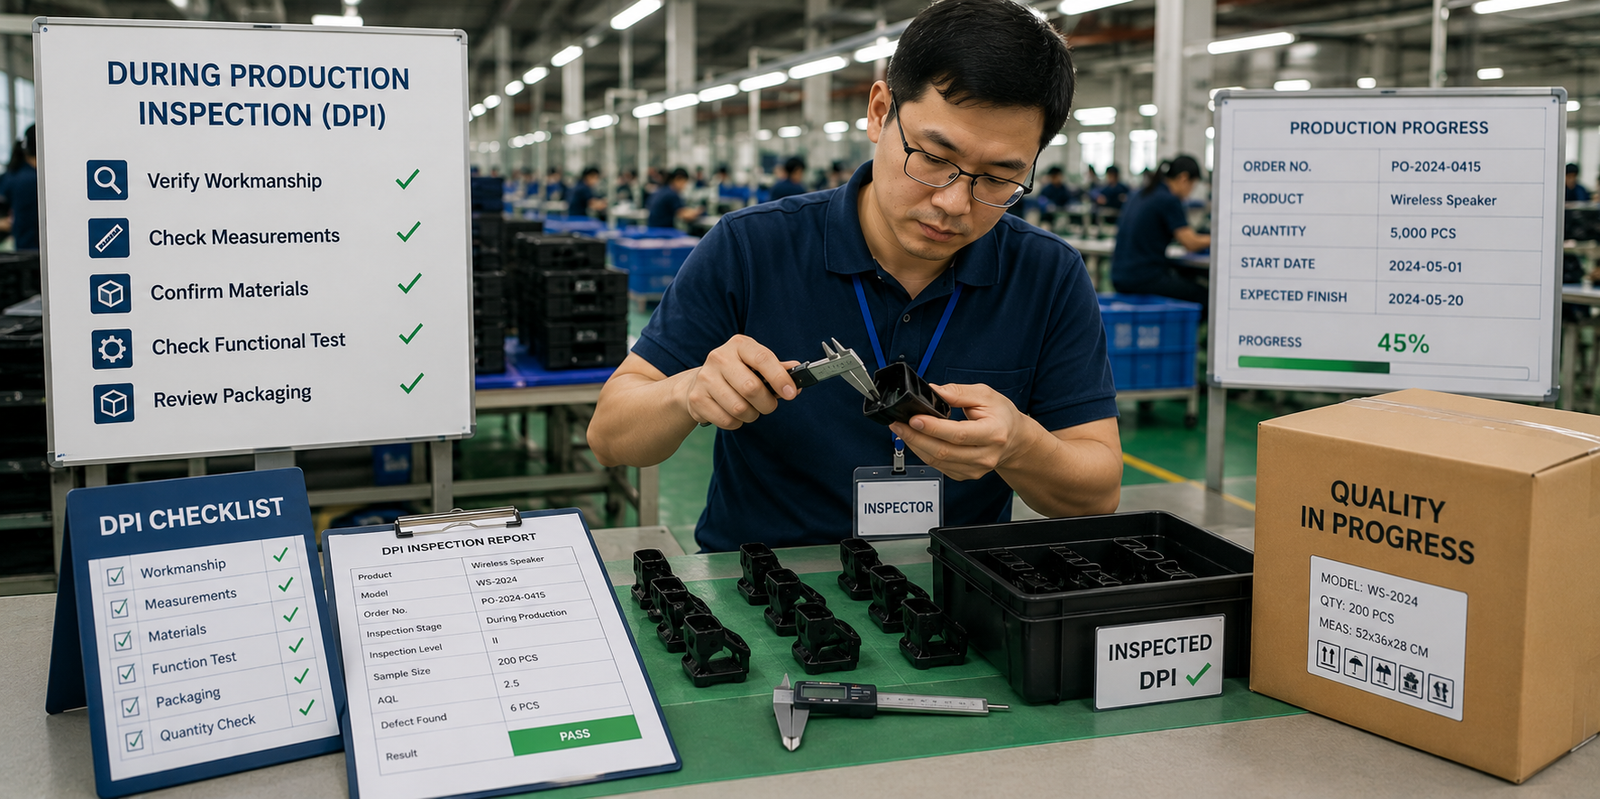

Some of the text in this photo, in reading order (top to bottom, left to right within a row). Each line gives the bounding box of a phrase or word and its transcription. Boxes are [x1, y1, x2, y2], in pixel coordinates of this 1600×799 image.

[108, 61, 409, 90] DURING PRODUCTION
[139, 102, 386, 130] INSPECTION (DPI)
[1290, 121, 1489, 135] PRODUCTION PROGRESS
[1243, 161, 1312, 172] ORDER NO.
[1391, 161, 1481, 173] PO-2024-0415
[148, 173, 323, 193] Verify Workmanship
[1243, 193, 1304, 204] PRODUCT
[1391, 194, 1497, 208] Wireless Speaker
[149, 228, 340, 246] Check Measurements
[1242, 225, 1306, 237] QUANTITY
[1390, 228, 1456, 240] 5,000 PCS
[1241, 257, 1315, 269] START DATE
[1389, 260, 1462, 273] 2024-05-01
[151, 281, 309, 301] Confirm Materials
[1240, 289, 1347, 303] EXPECTED FINISH
[1389, 293, 1464, 306] 2024-05-20
[152, 332, 346, 355] Check Functional Test
[1239, 335, 1302, 348] PROGRESS
[1378, 333, 1430, 354] 45%
[154, 385, 312, 408] Review Packaging
[864, 501, 933, 514] INSPECTOR
[1331, 479, 1446, 525] QUALITY
[100, 497, 284, 536] DPI CHECKLIST
[1301, 505, 1475, 565] IN PROGRESS
[382, 532, 537, 556] DPI INSPECTION REPORT
[140, 559, 226, 579] Workmanship
[471, 555, 545, 569] Wireless Speaker
[358, 570, 392, 581] Product
[476, 576, 518, 587] WS-2024
[361, 589, 389, 599] Model
[1321, 572, 1418, 607] MODEL: WS-2024
[145, 588, 237, 610] Measurements
[481, 591, 546, 605] PO-2024-0415
[363, 607, 407, 618] Order No.
[486, 608, 567, 626] During Production
[1320, 595, 1395, 625] QTY: 200 PCS
[149, 624, 207, 642] Materials
[366, 622, 442, 638] Inspection Stage
[1319, 617, 1428, 658] MEAS: 52x36x28 CM
[369, 643, 443, 659] Inspection Level
[1109, 634, 1212, 661] INSPECTED
[152, 652, 237, 675] Function Test
[498, 653, 538, 666] 200 PCS
[373, 666, 431, 682] Sample Size
[1140, 668, 1176, 690] DPI
[504, 679, 520, 689] 2.5
[157, 688, 221, 708] Packaging
[377, 695, 398, 705] AQL
[510, 701, 540, 712] 6 PCS
[160, 714, 256, 742] Quantity Check
[381, 713, 447, 730] Defect Found
[559, 728, 591, 742] PASS
[386, 749, 418, 761] Result
